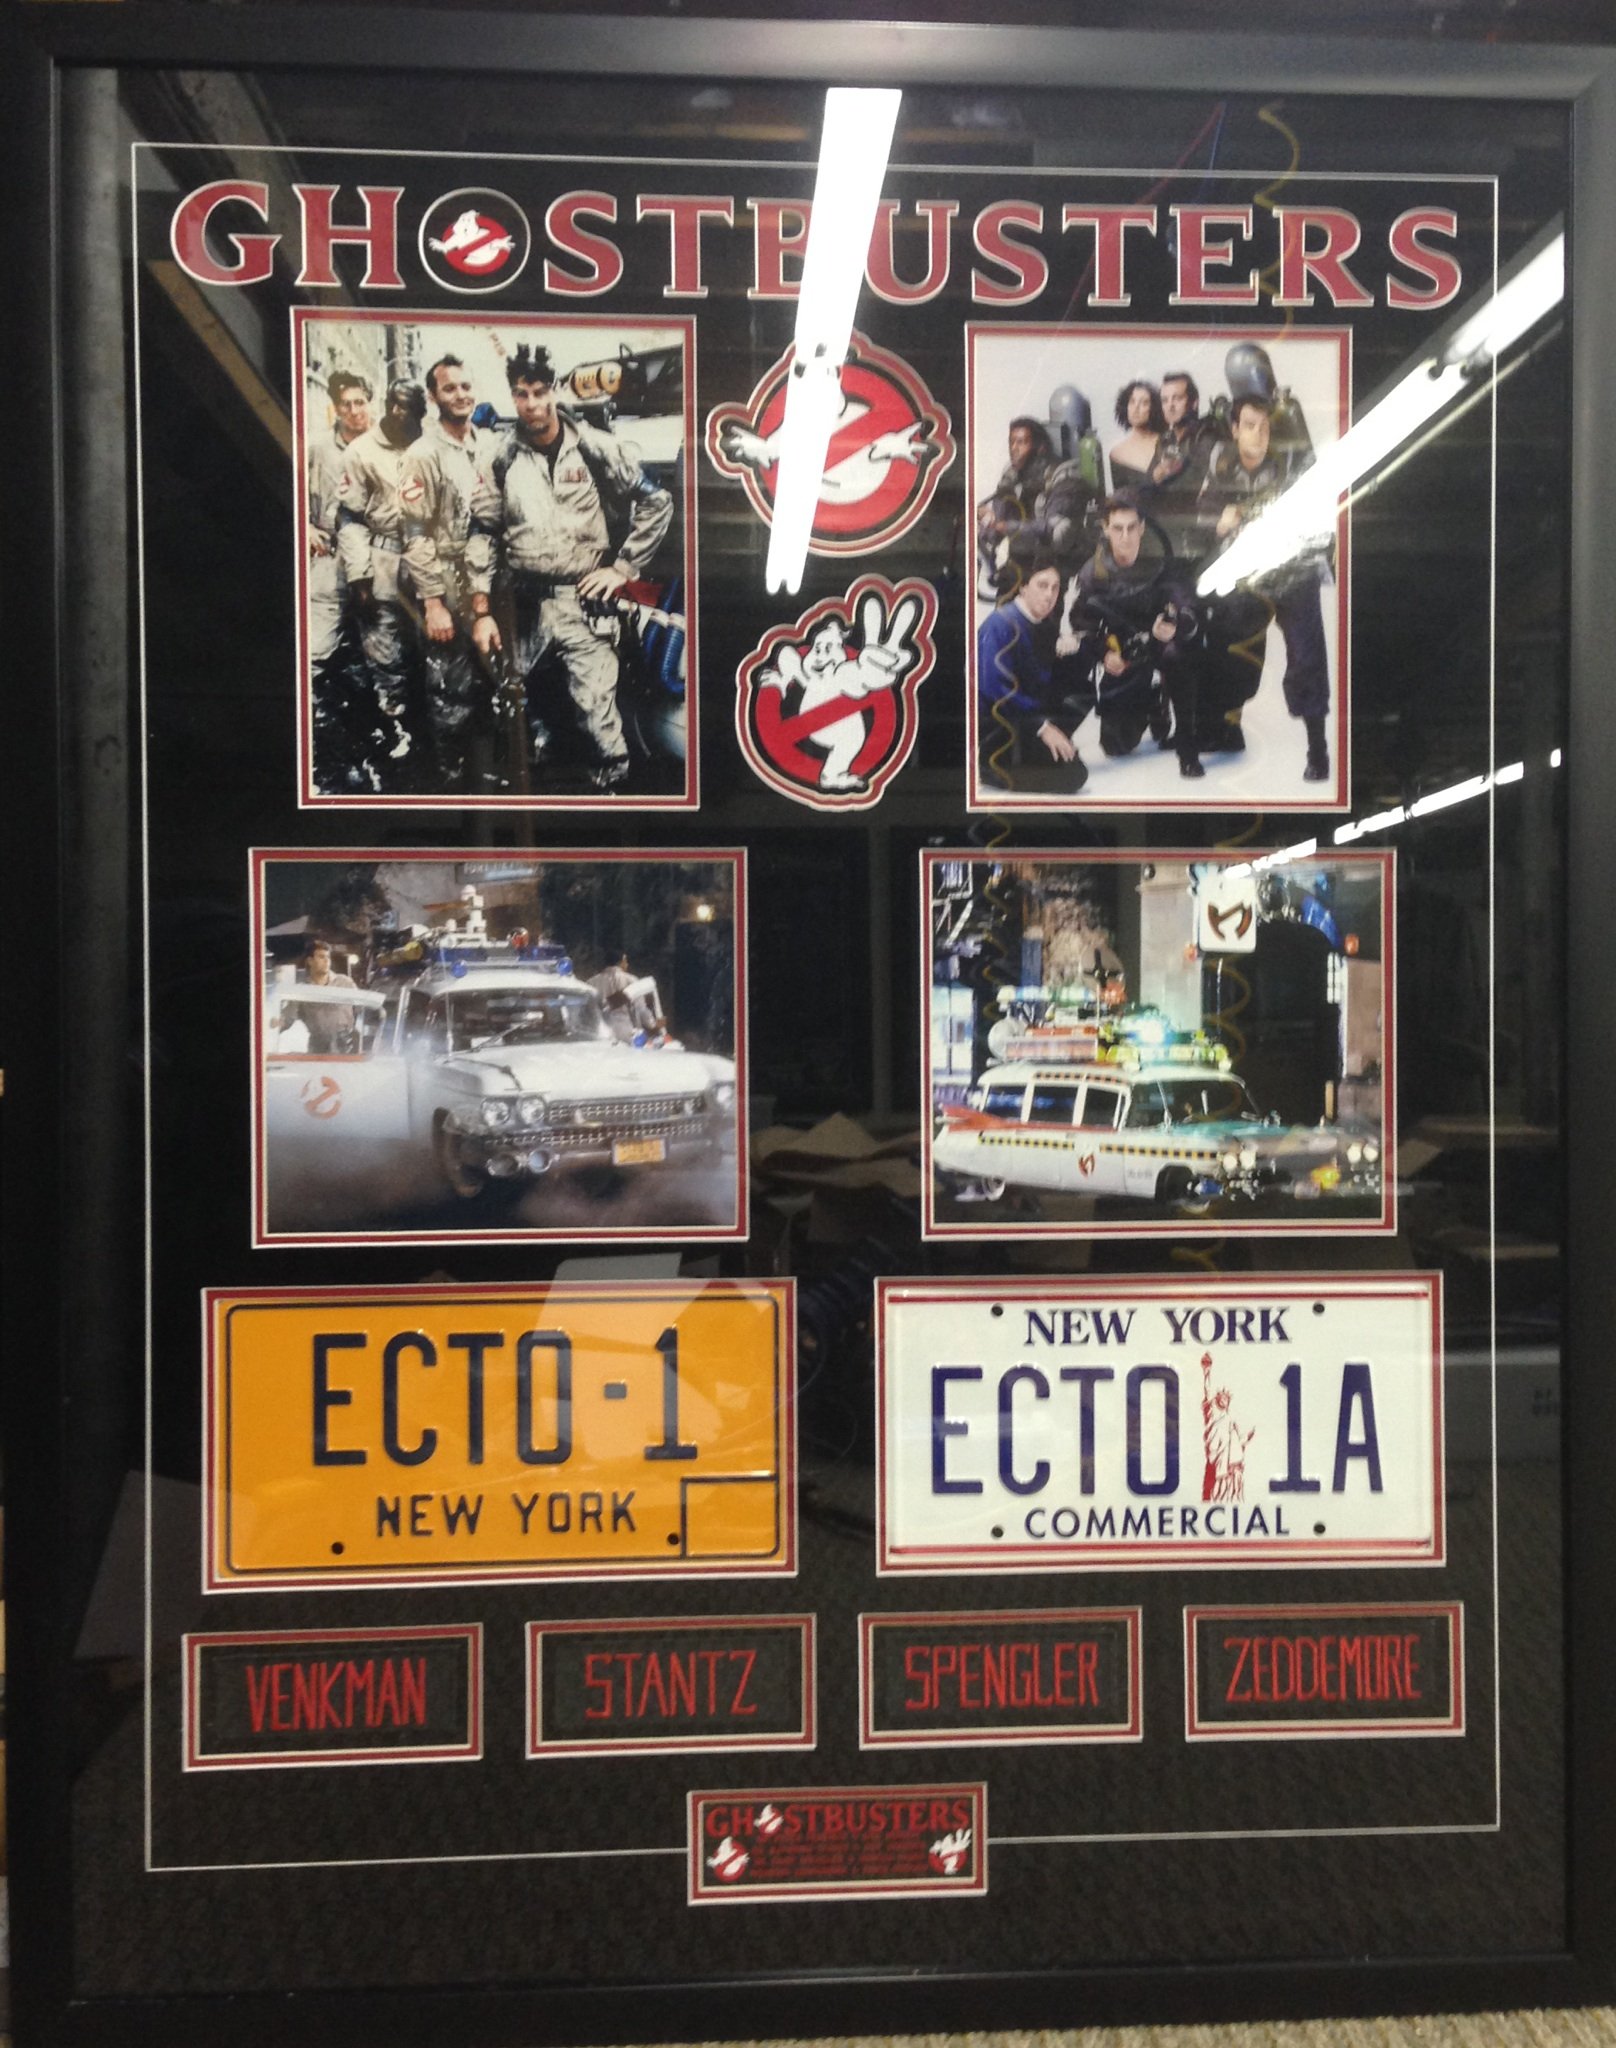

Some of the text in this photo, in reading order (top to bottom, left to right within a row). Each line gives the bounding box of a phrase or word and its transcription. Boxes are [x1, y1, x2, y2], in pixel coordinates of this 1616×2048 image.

[170, 178, 1463, 311] GHOSTBUSTERS
[1024, 1306, 1290, 1346] NEW YORK
[312, 1326, 698, 1467] ECTO-1
[931, 1361, 1384, 1496] ECTO 1A
[376, 1490, 638, 1538] NEW YORK
[1024, 1503, 1290, 1539] COMMERCIAL
[245, 1657, 427, 1733] VENKMAN
[584, 1649, 758, 1720] STANTZ
[904, 1641, 1099, 1711] SPENGLER
[1223, 1633, 1423, 1703] ZEDDEMORE
[705, 1799, 971, 1838] GHOSTBUSTERS
